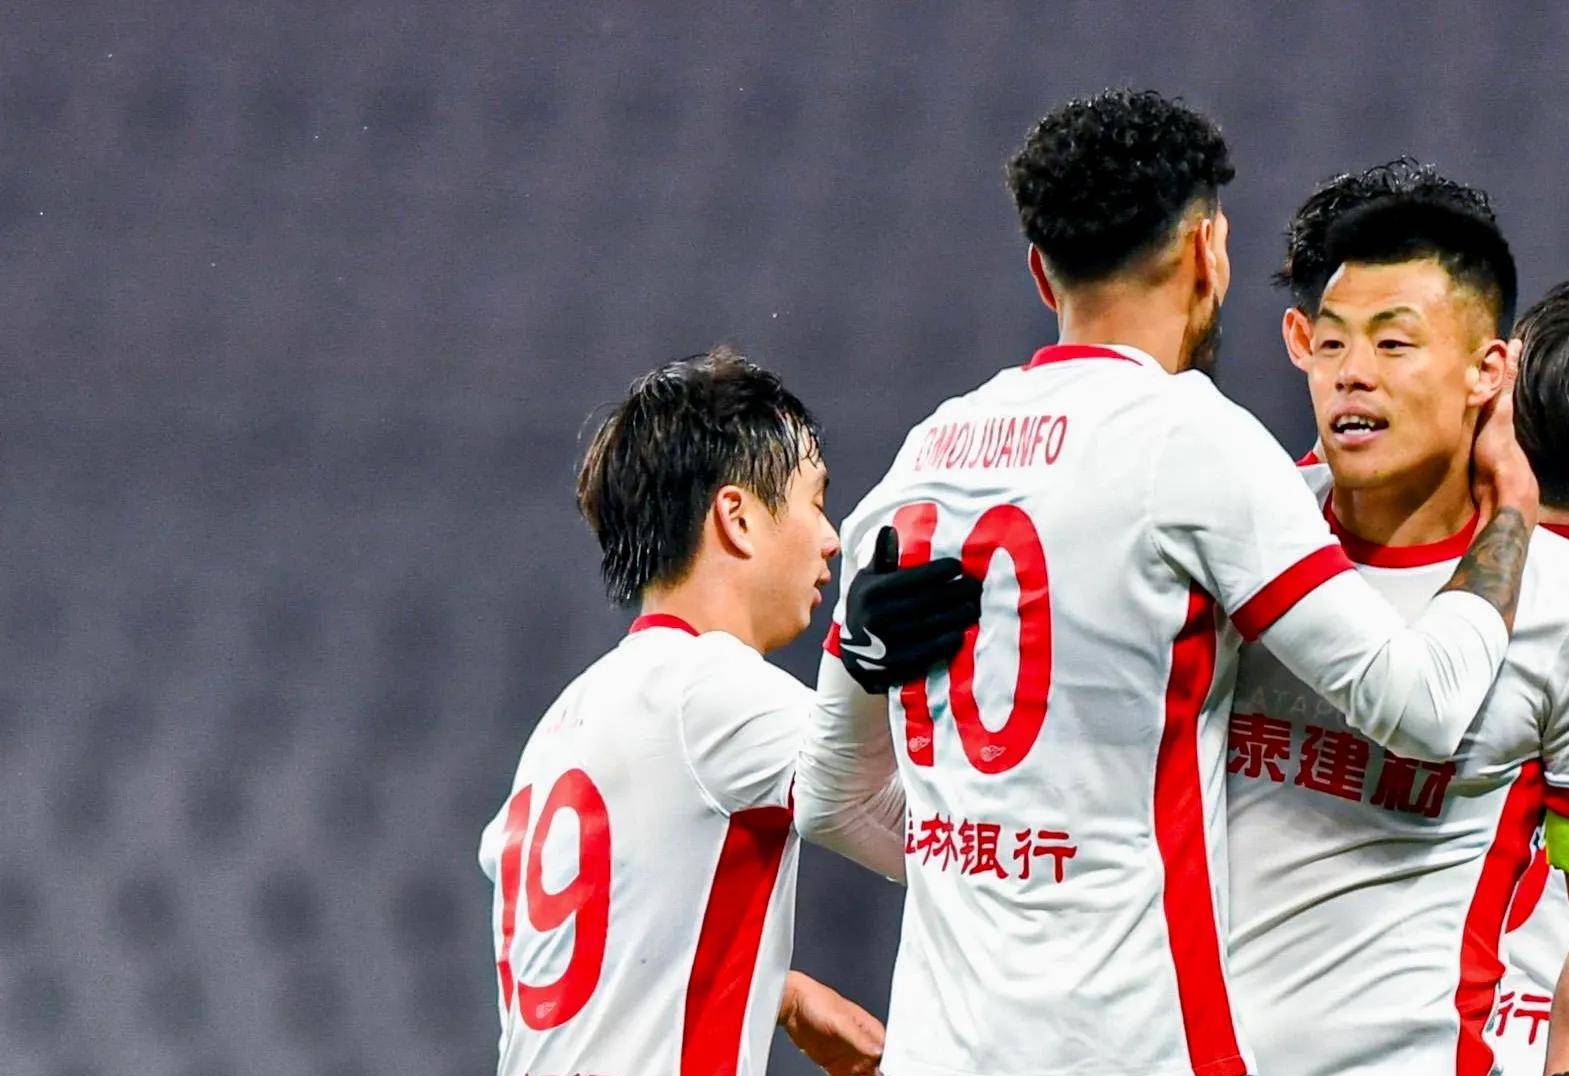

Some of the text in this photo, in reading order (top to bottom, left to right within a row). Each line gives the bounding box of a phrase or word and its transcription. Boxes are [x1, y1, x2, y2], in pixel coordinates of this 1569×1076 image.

[892, 502, 1052, 774] 10
[496, 768, 612, 1031] 19
[905, 810, 1078, 884] 林银行
